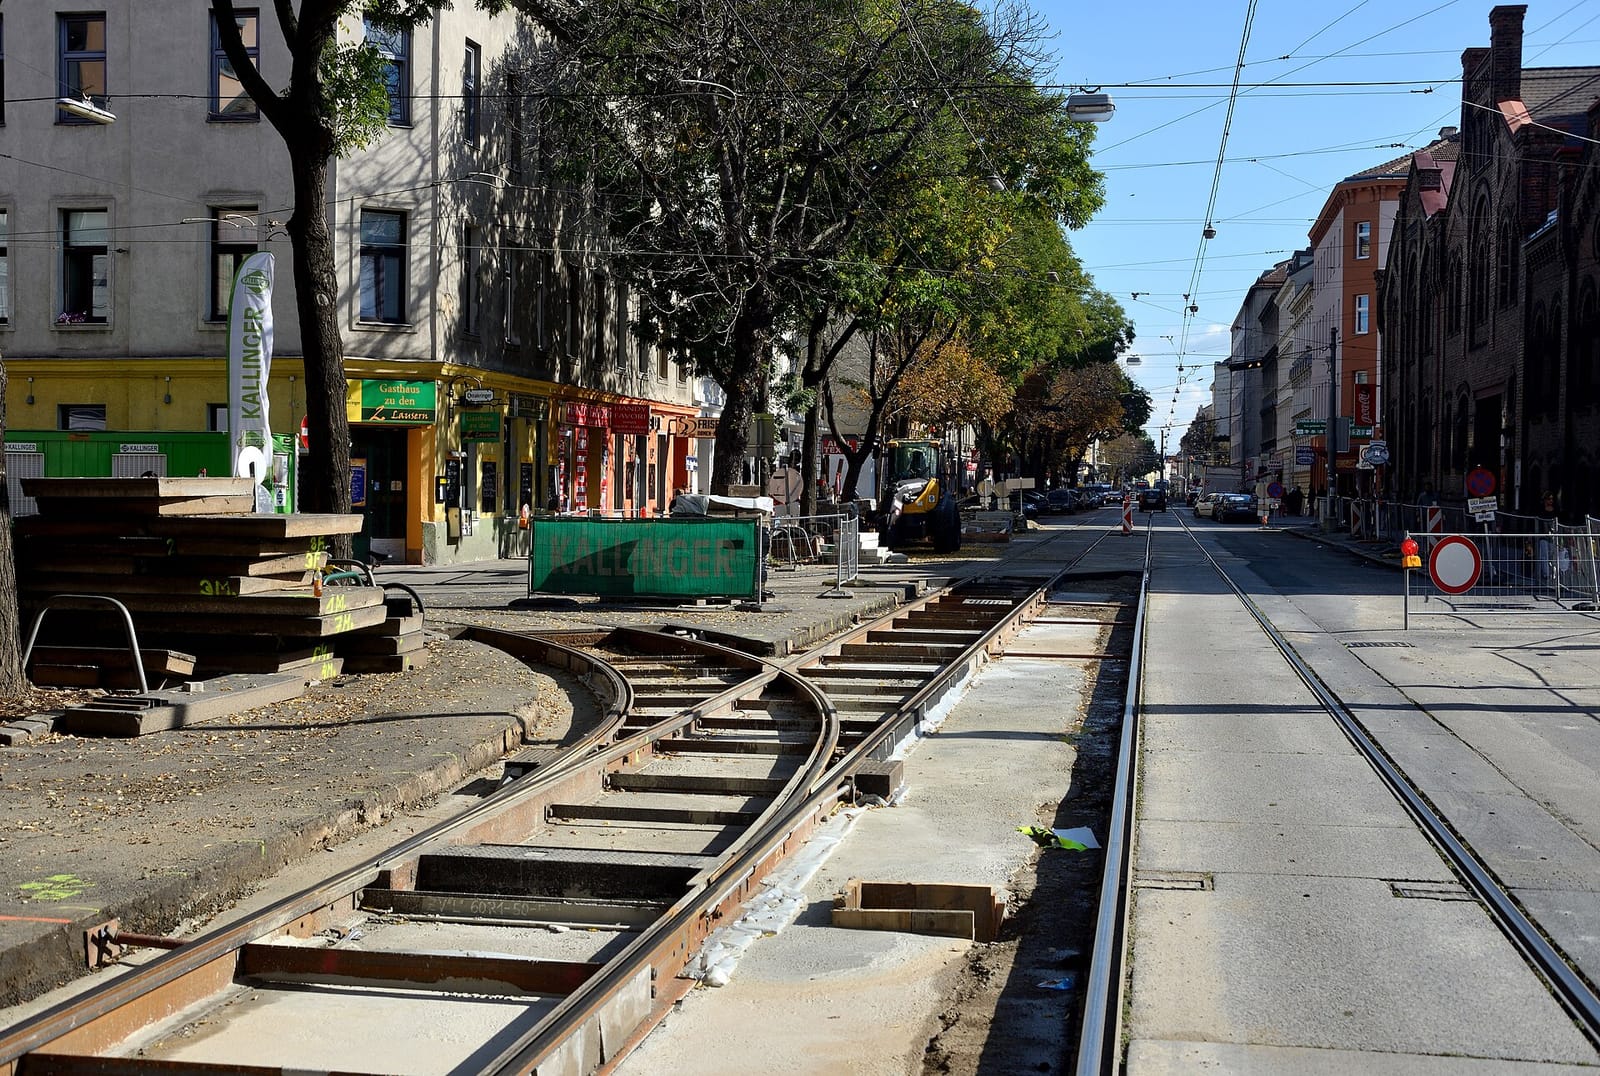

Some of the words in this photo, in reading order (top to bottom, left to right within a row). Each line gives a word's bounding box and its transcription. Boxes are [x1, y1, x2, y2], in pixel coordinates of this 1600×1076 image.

[241, 306, 265, 420] KALLINGER
[379, 383, 420, 394] Gasthaus
[384, 397, 396, 405] zu
[398, 395, 416, 406] den
[613, 405, 648, 413] HANDY
[390, 410, 429, 421] Lausern
[549, 534, 737, 578] KALLINGER
